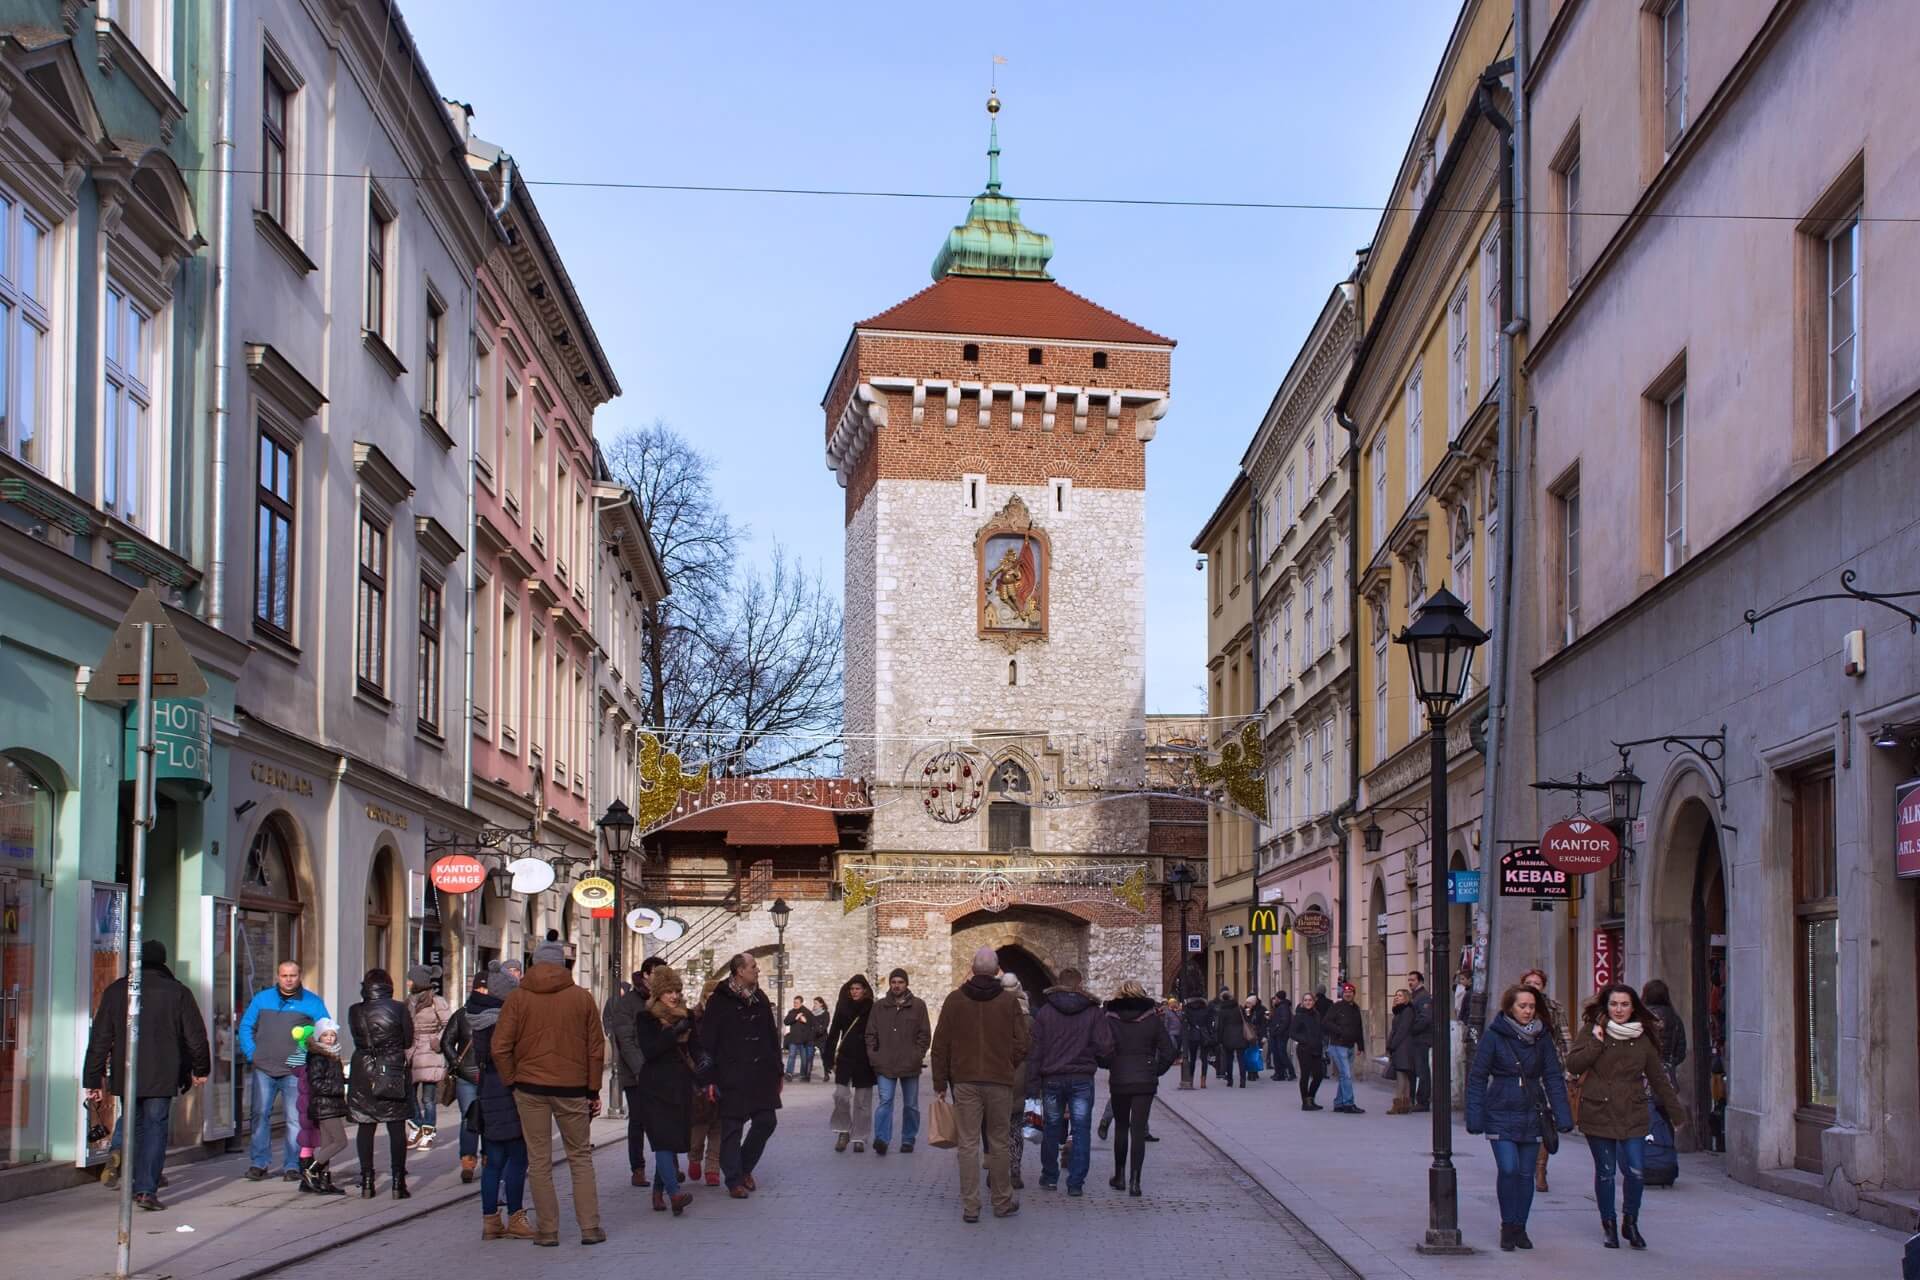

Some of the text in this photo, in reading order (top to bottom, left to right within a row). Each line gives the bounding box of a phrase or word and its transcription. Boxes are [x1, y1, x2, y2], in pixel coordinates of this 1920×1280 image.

[1550, 839, 1611, 851] KANTOR
[1559, 855, 1601, 863] EXCHANGE
[437, 864, 480, 873] KANTOR
[436, 875, 480, 884] CHANGE
[1505, 870, 1566, 883] KEBAB
[1595, 934, 1609, 993] EXC
